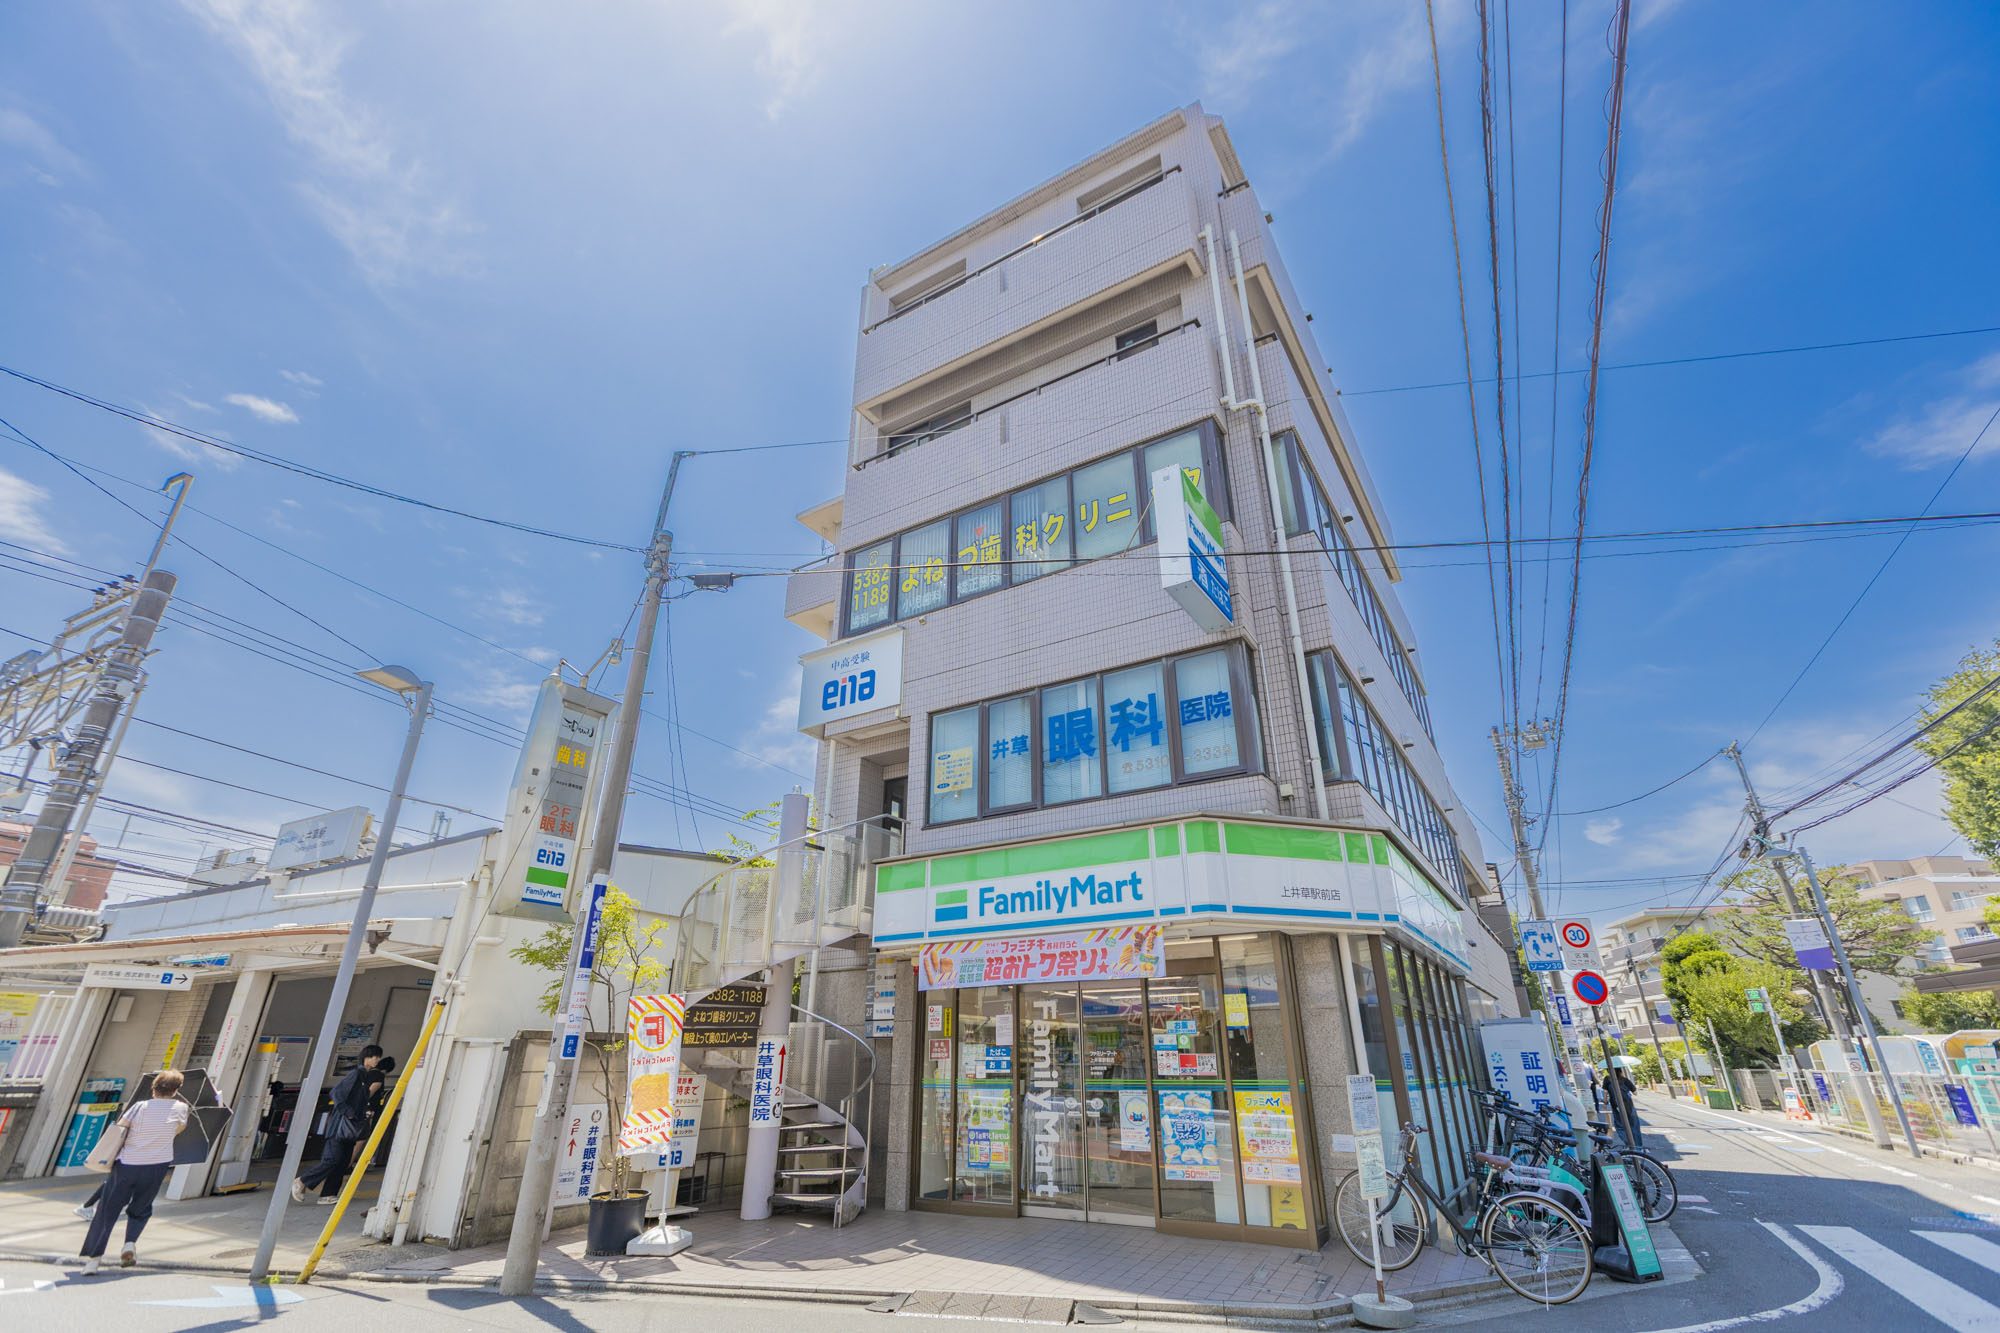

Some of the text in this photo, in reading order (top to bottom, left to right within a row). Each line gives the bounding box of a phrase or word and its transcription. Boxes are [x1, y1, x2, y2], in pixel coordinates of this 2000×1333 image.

[1188, 514, 1226, 572] FamilyMart
[854, 564, 891, 592] 5382
[853, 583, 889, 611] 1188
[831, 651, 871, 671] 中高受験
[556, 745, 587, 769] 歯科
[550, 804, 572, 817] 2F
[540, 815, 574, 836] 眼科
[525, 886, 562, 899] FamilyMart
[979, 871, 1143, 917] FamilyMart
[1281, 886, 1341, 901] 上井草駅前店
[1568, 929, 1585, 942] 30
[1001, 938, 1046, 954] ファミチキ
[1530, 962, 1562, 970] ゾーン30
[693, 1011, 756, 1023] よねづ歯科クリニック
[989, 1048, 1007, 1056] たばこ
[751, 1042, 775, 1121] 井草眼科医院
[1033, 1000, 1059, 1197] FamilyMart
[1245, 1097, 1281, 1107] ファミペイ
[570, 1118, 581, 1136] 2F
[1176, 1120, 1202, 1133] ミルク
[578, 1126, 599, 1198] 井草眼科医院
[1609, 1173, 1624, 1181] LUUP
